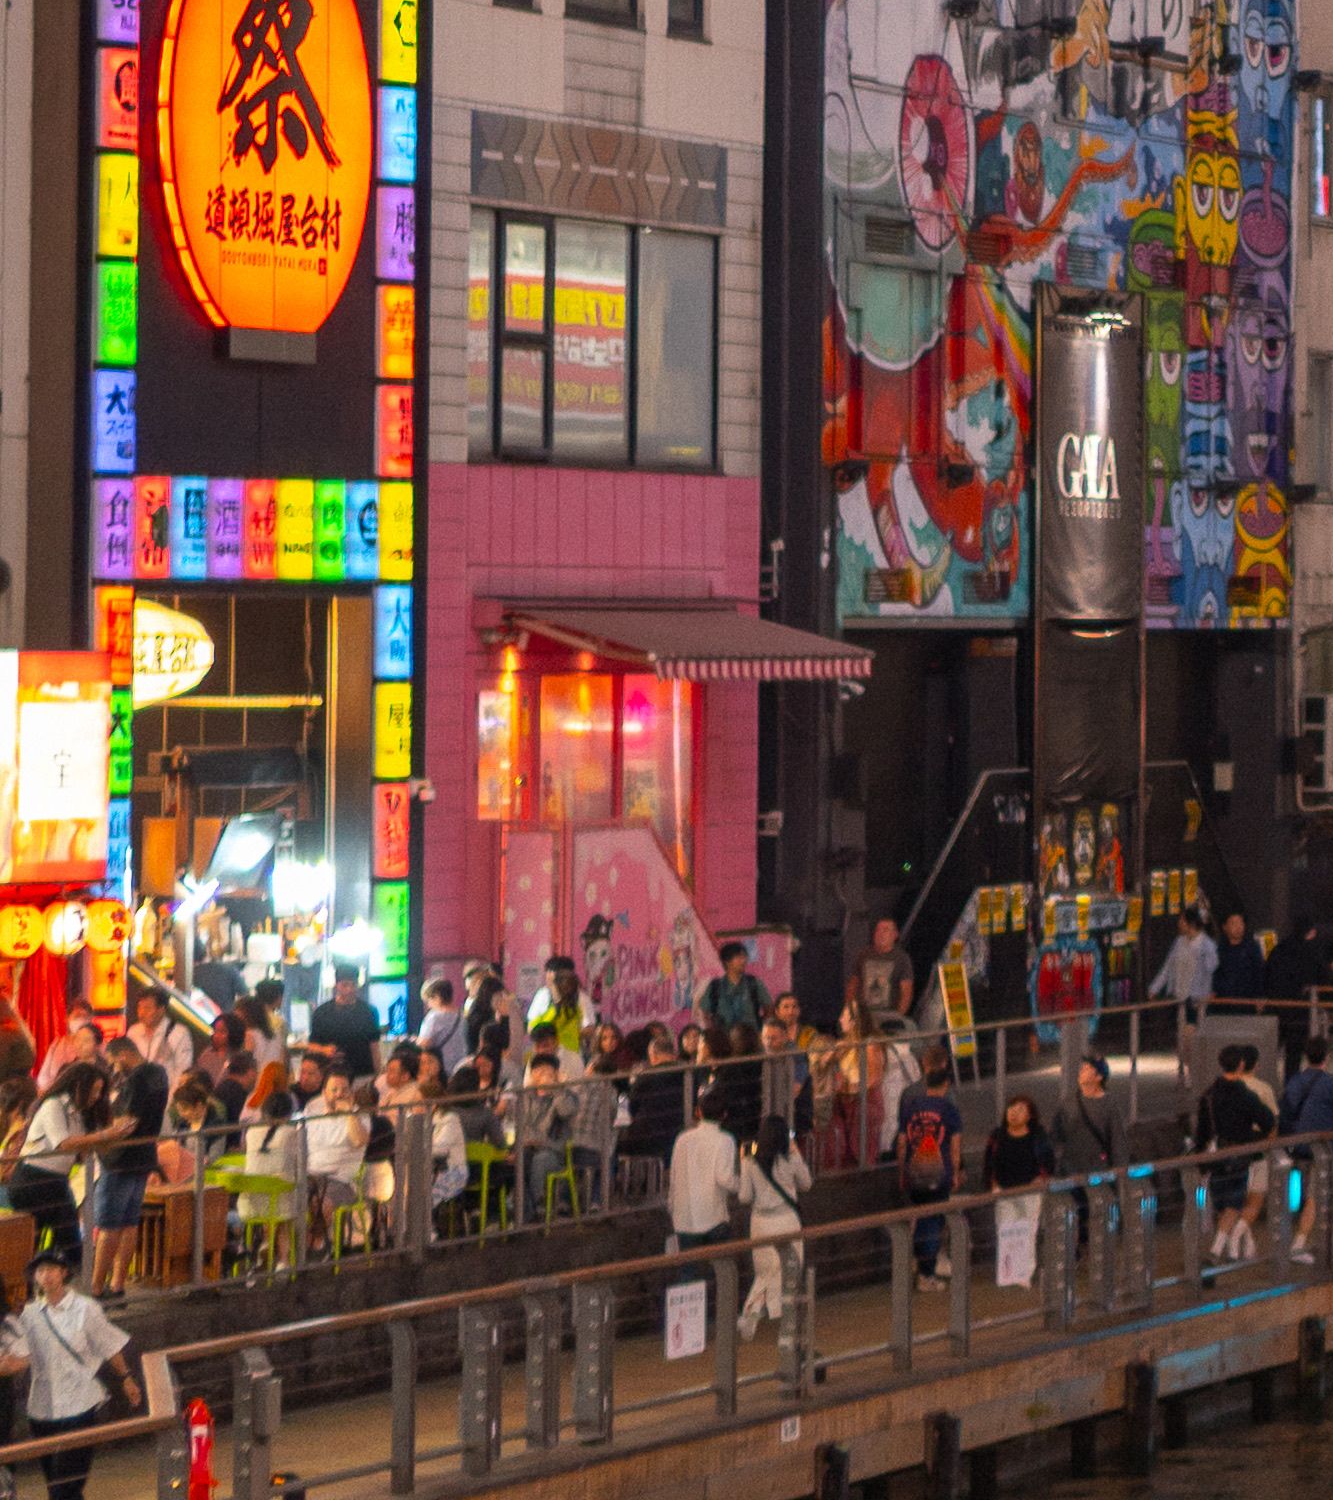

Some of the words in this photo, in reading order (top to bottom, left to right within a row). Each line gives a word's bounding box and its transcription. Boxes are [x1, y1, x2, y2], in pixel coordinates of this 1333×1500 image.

[205, 184, 342, 250] 道頓堀屋台村
